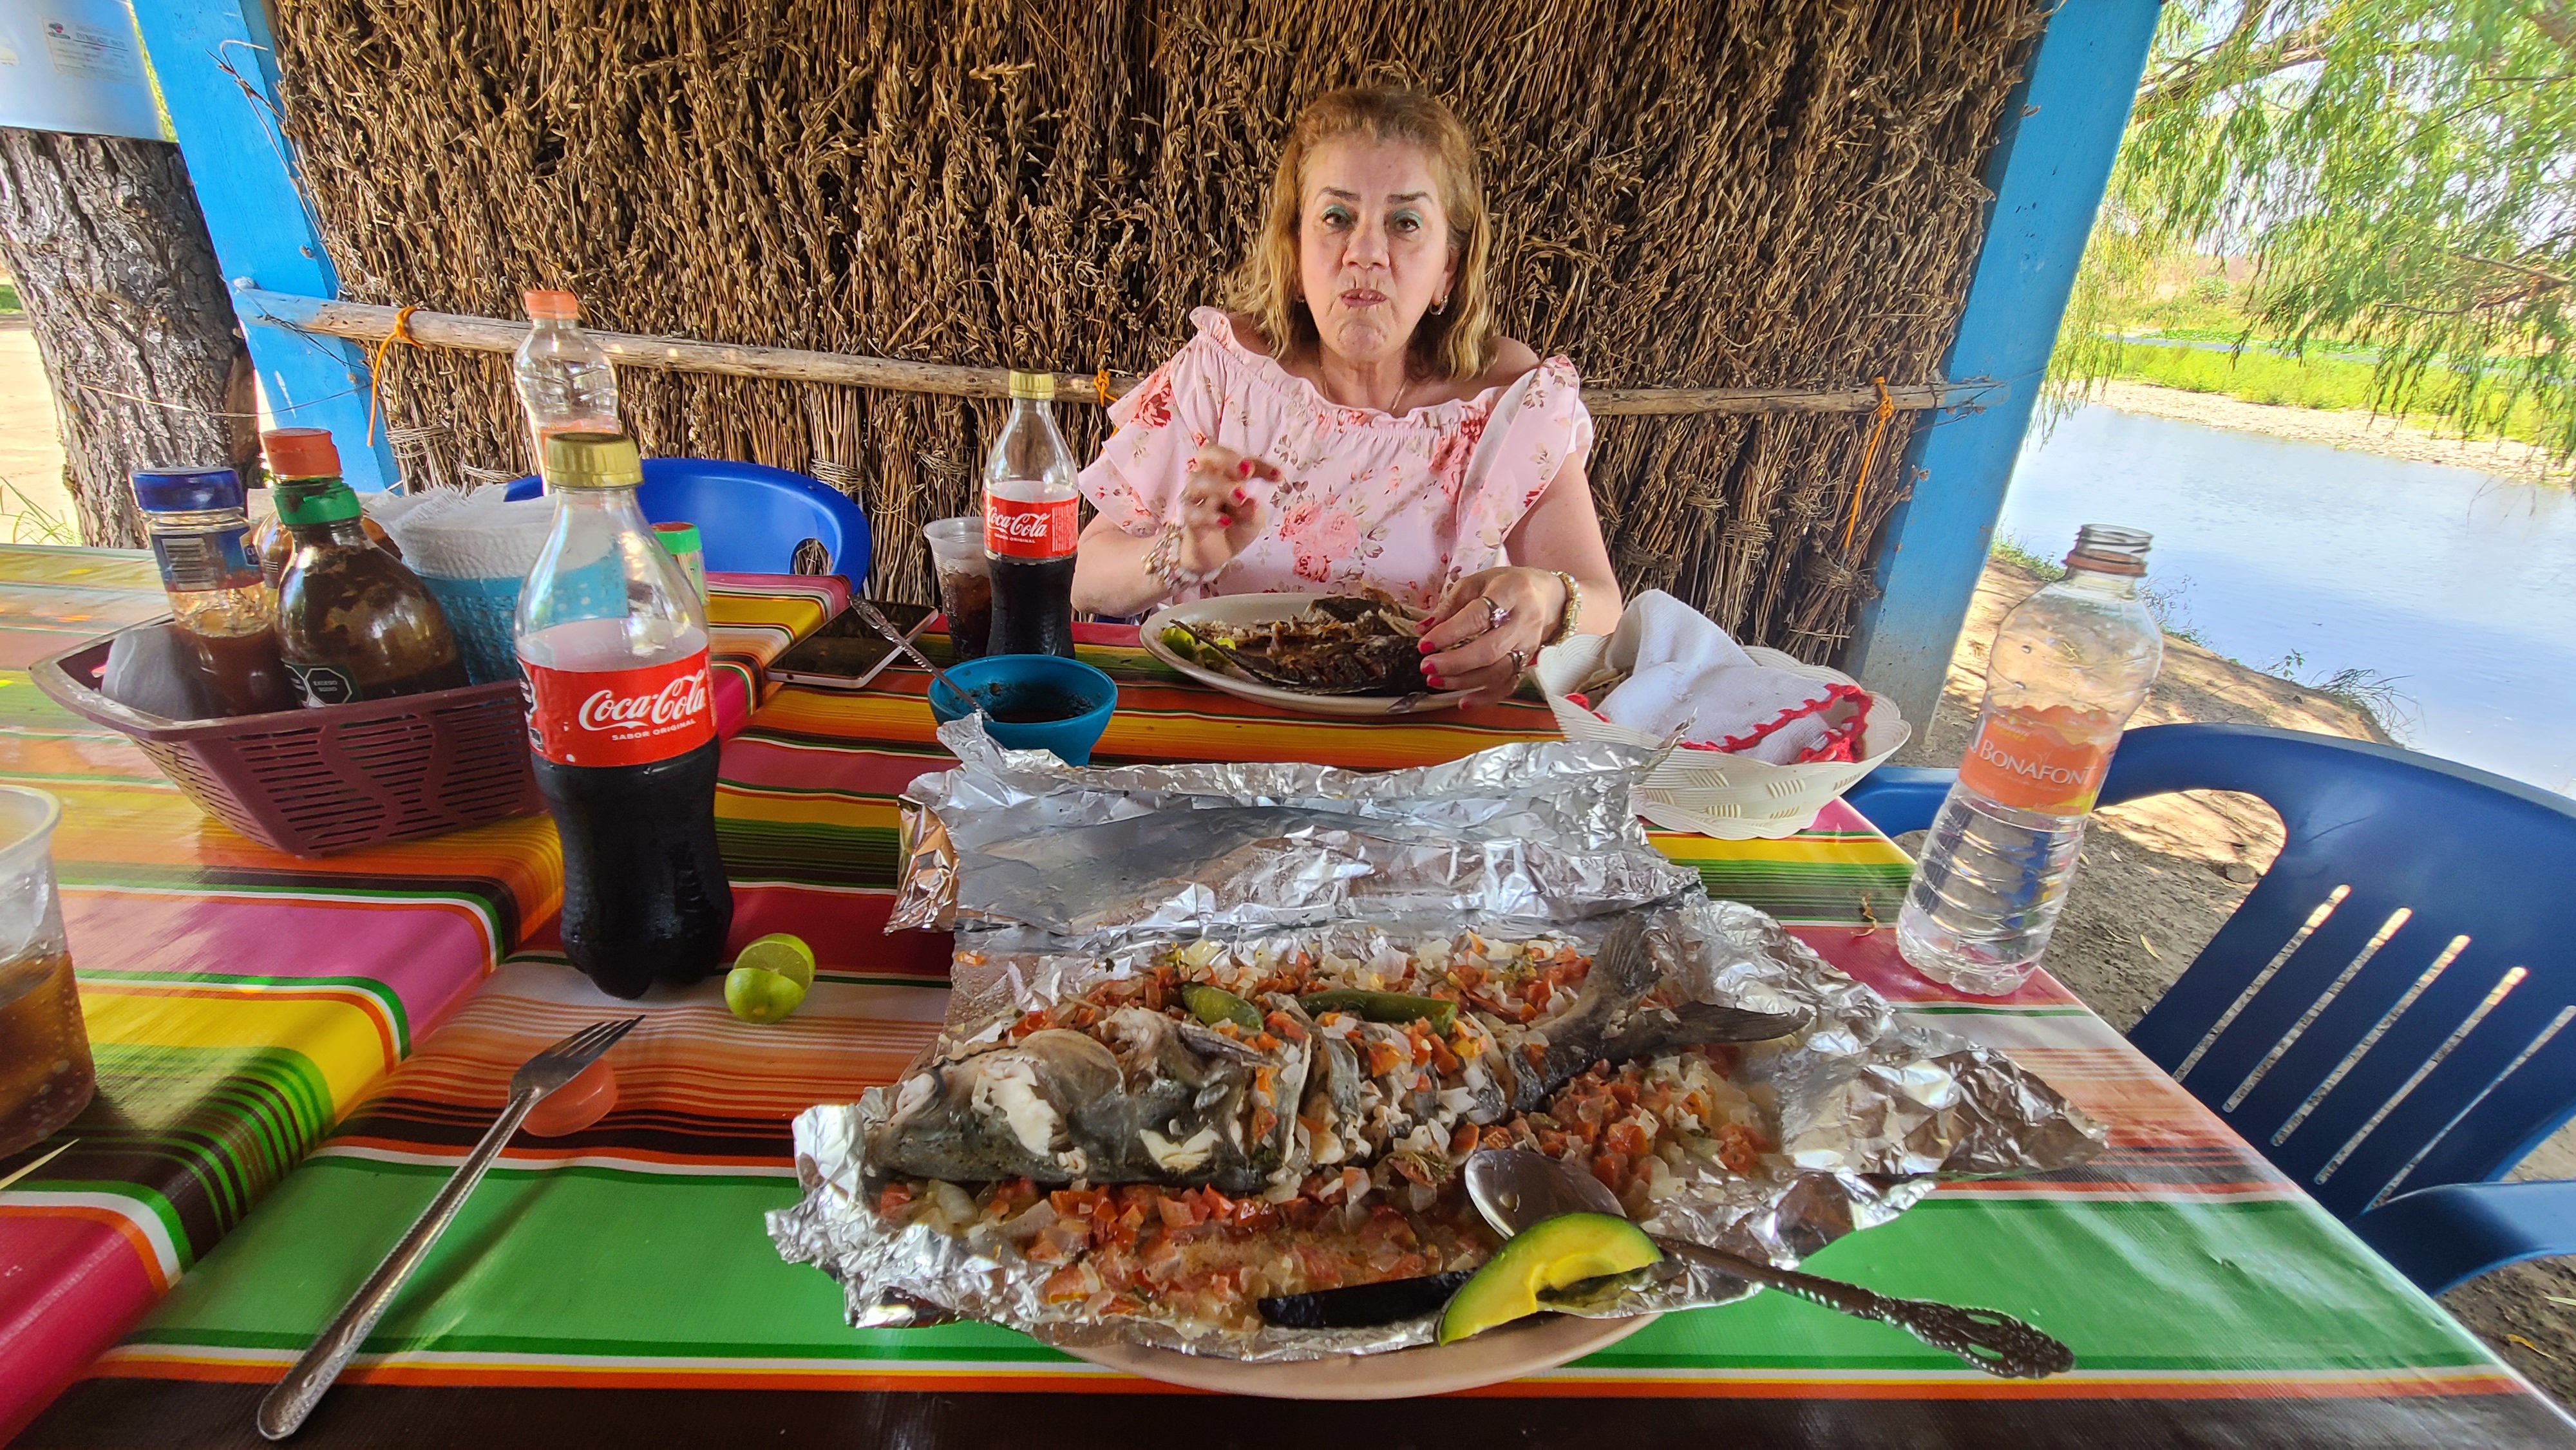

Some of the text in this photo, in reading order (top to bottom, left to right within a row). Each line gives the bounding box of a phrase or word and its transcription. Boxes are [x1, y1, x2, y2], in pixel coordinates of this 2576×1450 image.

[988, 507, 1052, 538] Coca-Cola
[578, 667, 706, 731] Coca-Cola
[612, 718, 696, 741] SABOR ORIGINAL
[1979, 739, 2098, 786] BONAFONT
